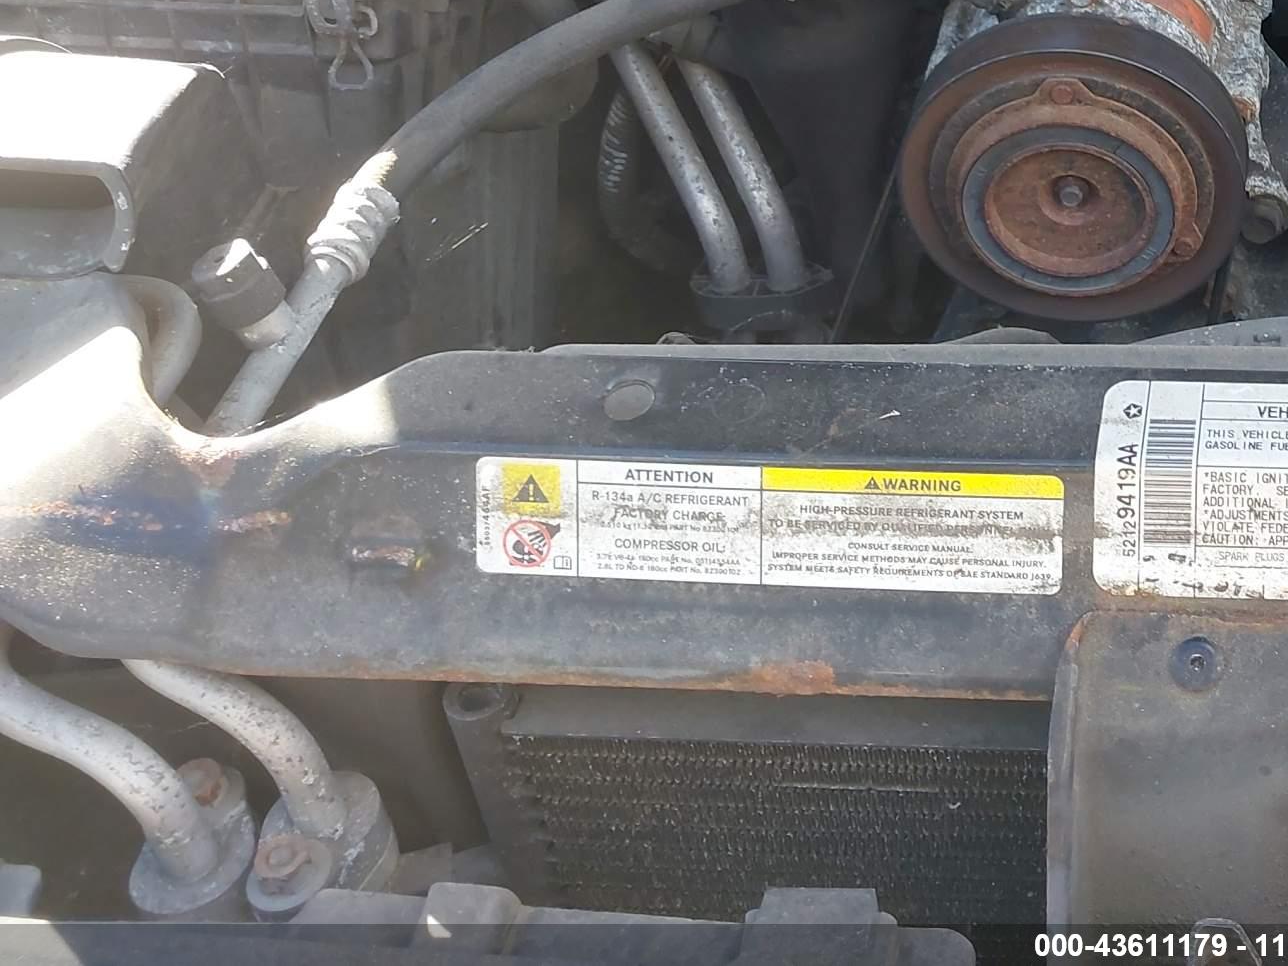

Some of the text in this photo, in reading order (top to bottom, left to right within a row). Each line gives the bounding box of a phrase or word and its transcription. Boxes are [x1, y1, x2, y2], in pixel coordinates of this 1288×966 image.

[1206, 429, 1235, 439] THIS
[1204, 440, 1262, 451] GASOLINE
[625, 468, 713, 483] ATTENTION
[883, 478, 961, 492] WARNING
[1202, 483, 1260, 496] FACTORY.
[592, 490, 749, 506] R-134a A/C REFRIGERANT
[1203, 496, 1275, 508] ADDITIONAL
[613, 507, 668, 521] FACTORY
[800, 505, 1024, 520] HIGH-PRESSURE REFRIGERANT SYSTEM
[768, 519, 783, 528] TO
[787, 519, 801, 529] BE
[1202, 521, 1254, 533] VIOLATE
[614, 538, 726, 553] COMPRESSOR OIL:
[848, 542, 889, 551] CONSULT
[892, 543, 929, 552] SERVICE
[771, 551, 1047, 568] IMPROPER SERVICE METHODS MAY CAUSE PERSONAL INJURY.
[1218, 551, 1249, 562] SPARK
[767, 563, 802, 572] SYSTEM
[805, 564, 835, 573] MEETS
[839, 565, 871, 575] SAFETY
[873, 566, 944, 577] REQUIREMENTS
[961, 570, 978, 579] SAE
[980, 571, 1029, 580] STANDARD
